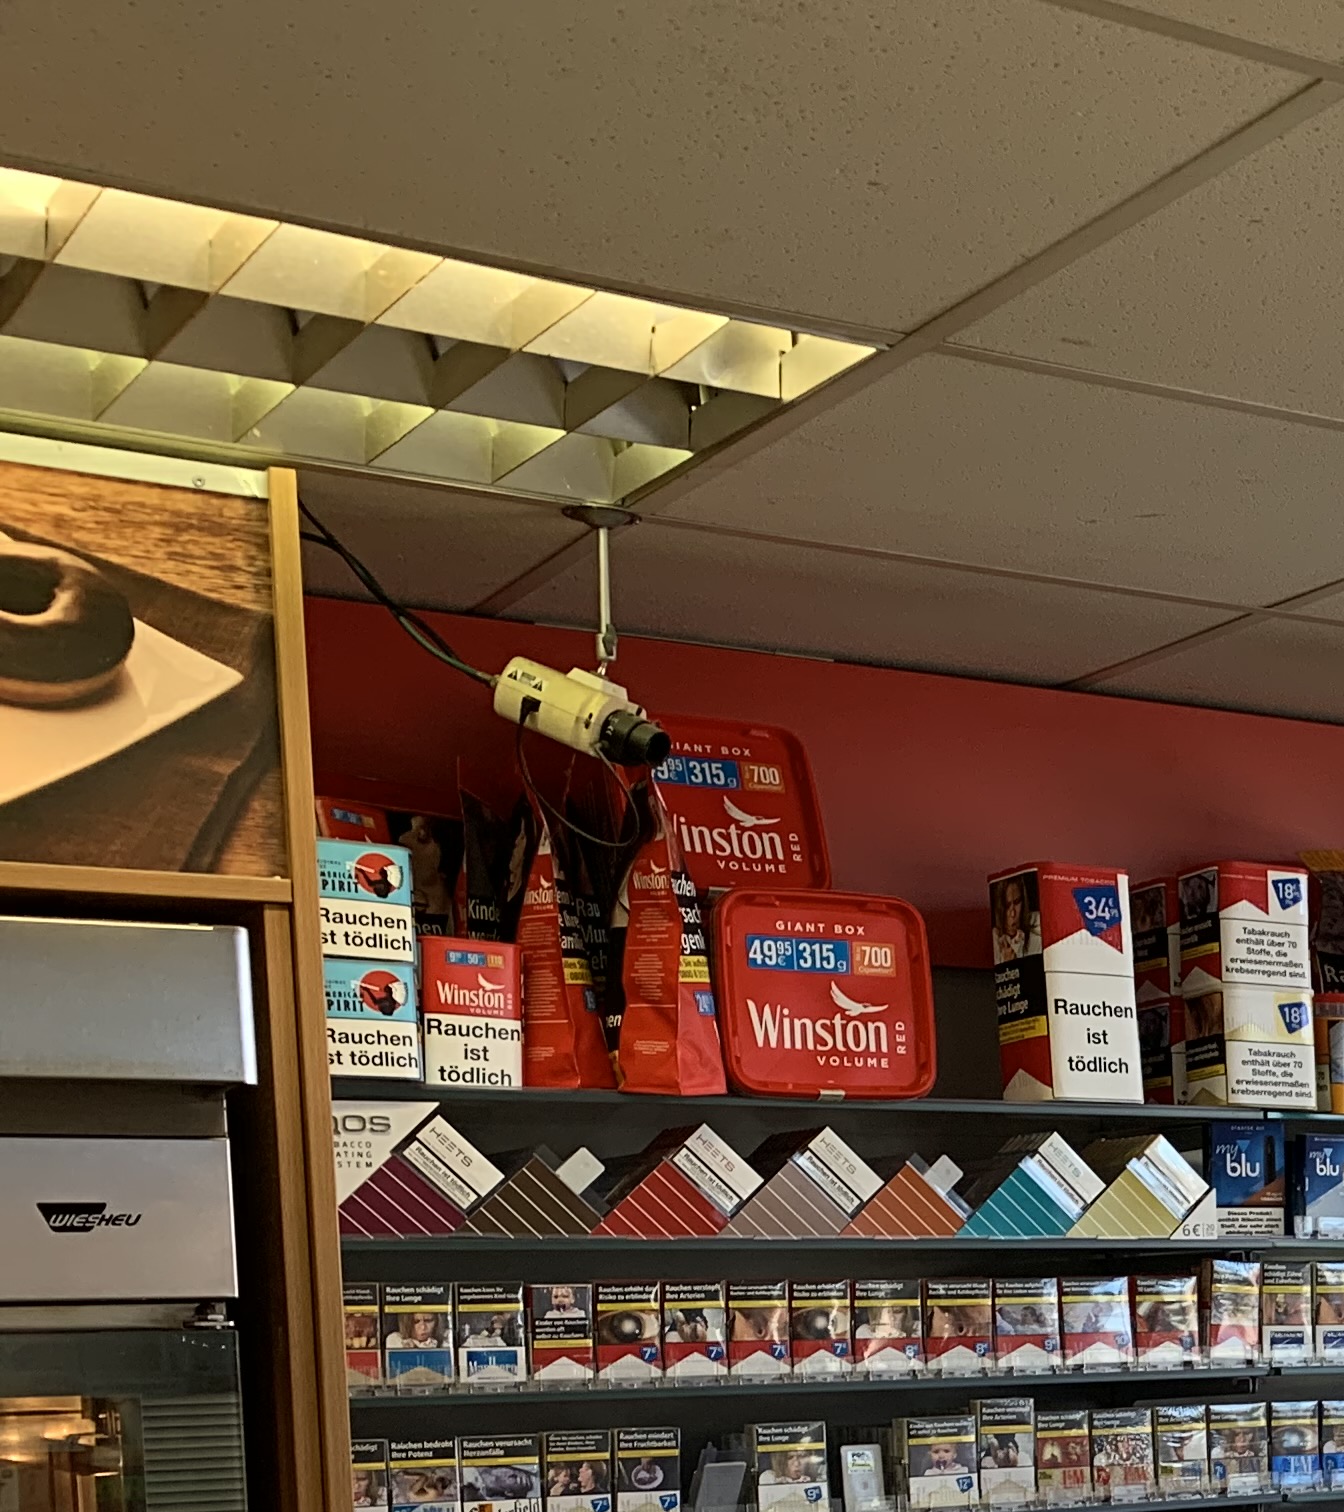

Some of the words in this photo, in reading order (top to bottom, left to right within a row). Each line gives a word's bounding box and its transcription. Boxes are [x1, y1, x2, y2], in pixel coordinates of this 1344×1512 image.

[776, 920, 825, 933] GIANT
[834, 924, 865, 936] BOX
[862, 947, 891, 967] 700
[437, 980, 504, 1009] Winston
[1054, 999, 1133, 1019] Rauchen
[426, 1018, 521, 1041] Rauchen
[746, 999, 889, 1053] Winston
[896, 1021, 906, 1054] RED
[1087, 1028, 1109, 1045] ist
[464, 1045, 489, 1061] ist
[817, 1055, 889, 1068] VOLUME
[1067, 1056, 1129, 1074] tödlich
[438, 1066, 512, 1087] tödlich
[429, 1127, 473, 1167] HEETS
[1225, 1153, 1261, 1179] blu
[49, 1213, 142, 1227] WIESHEU
